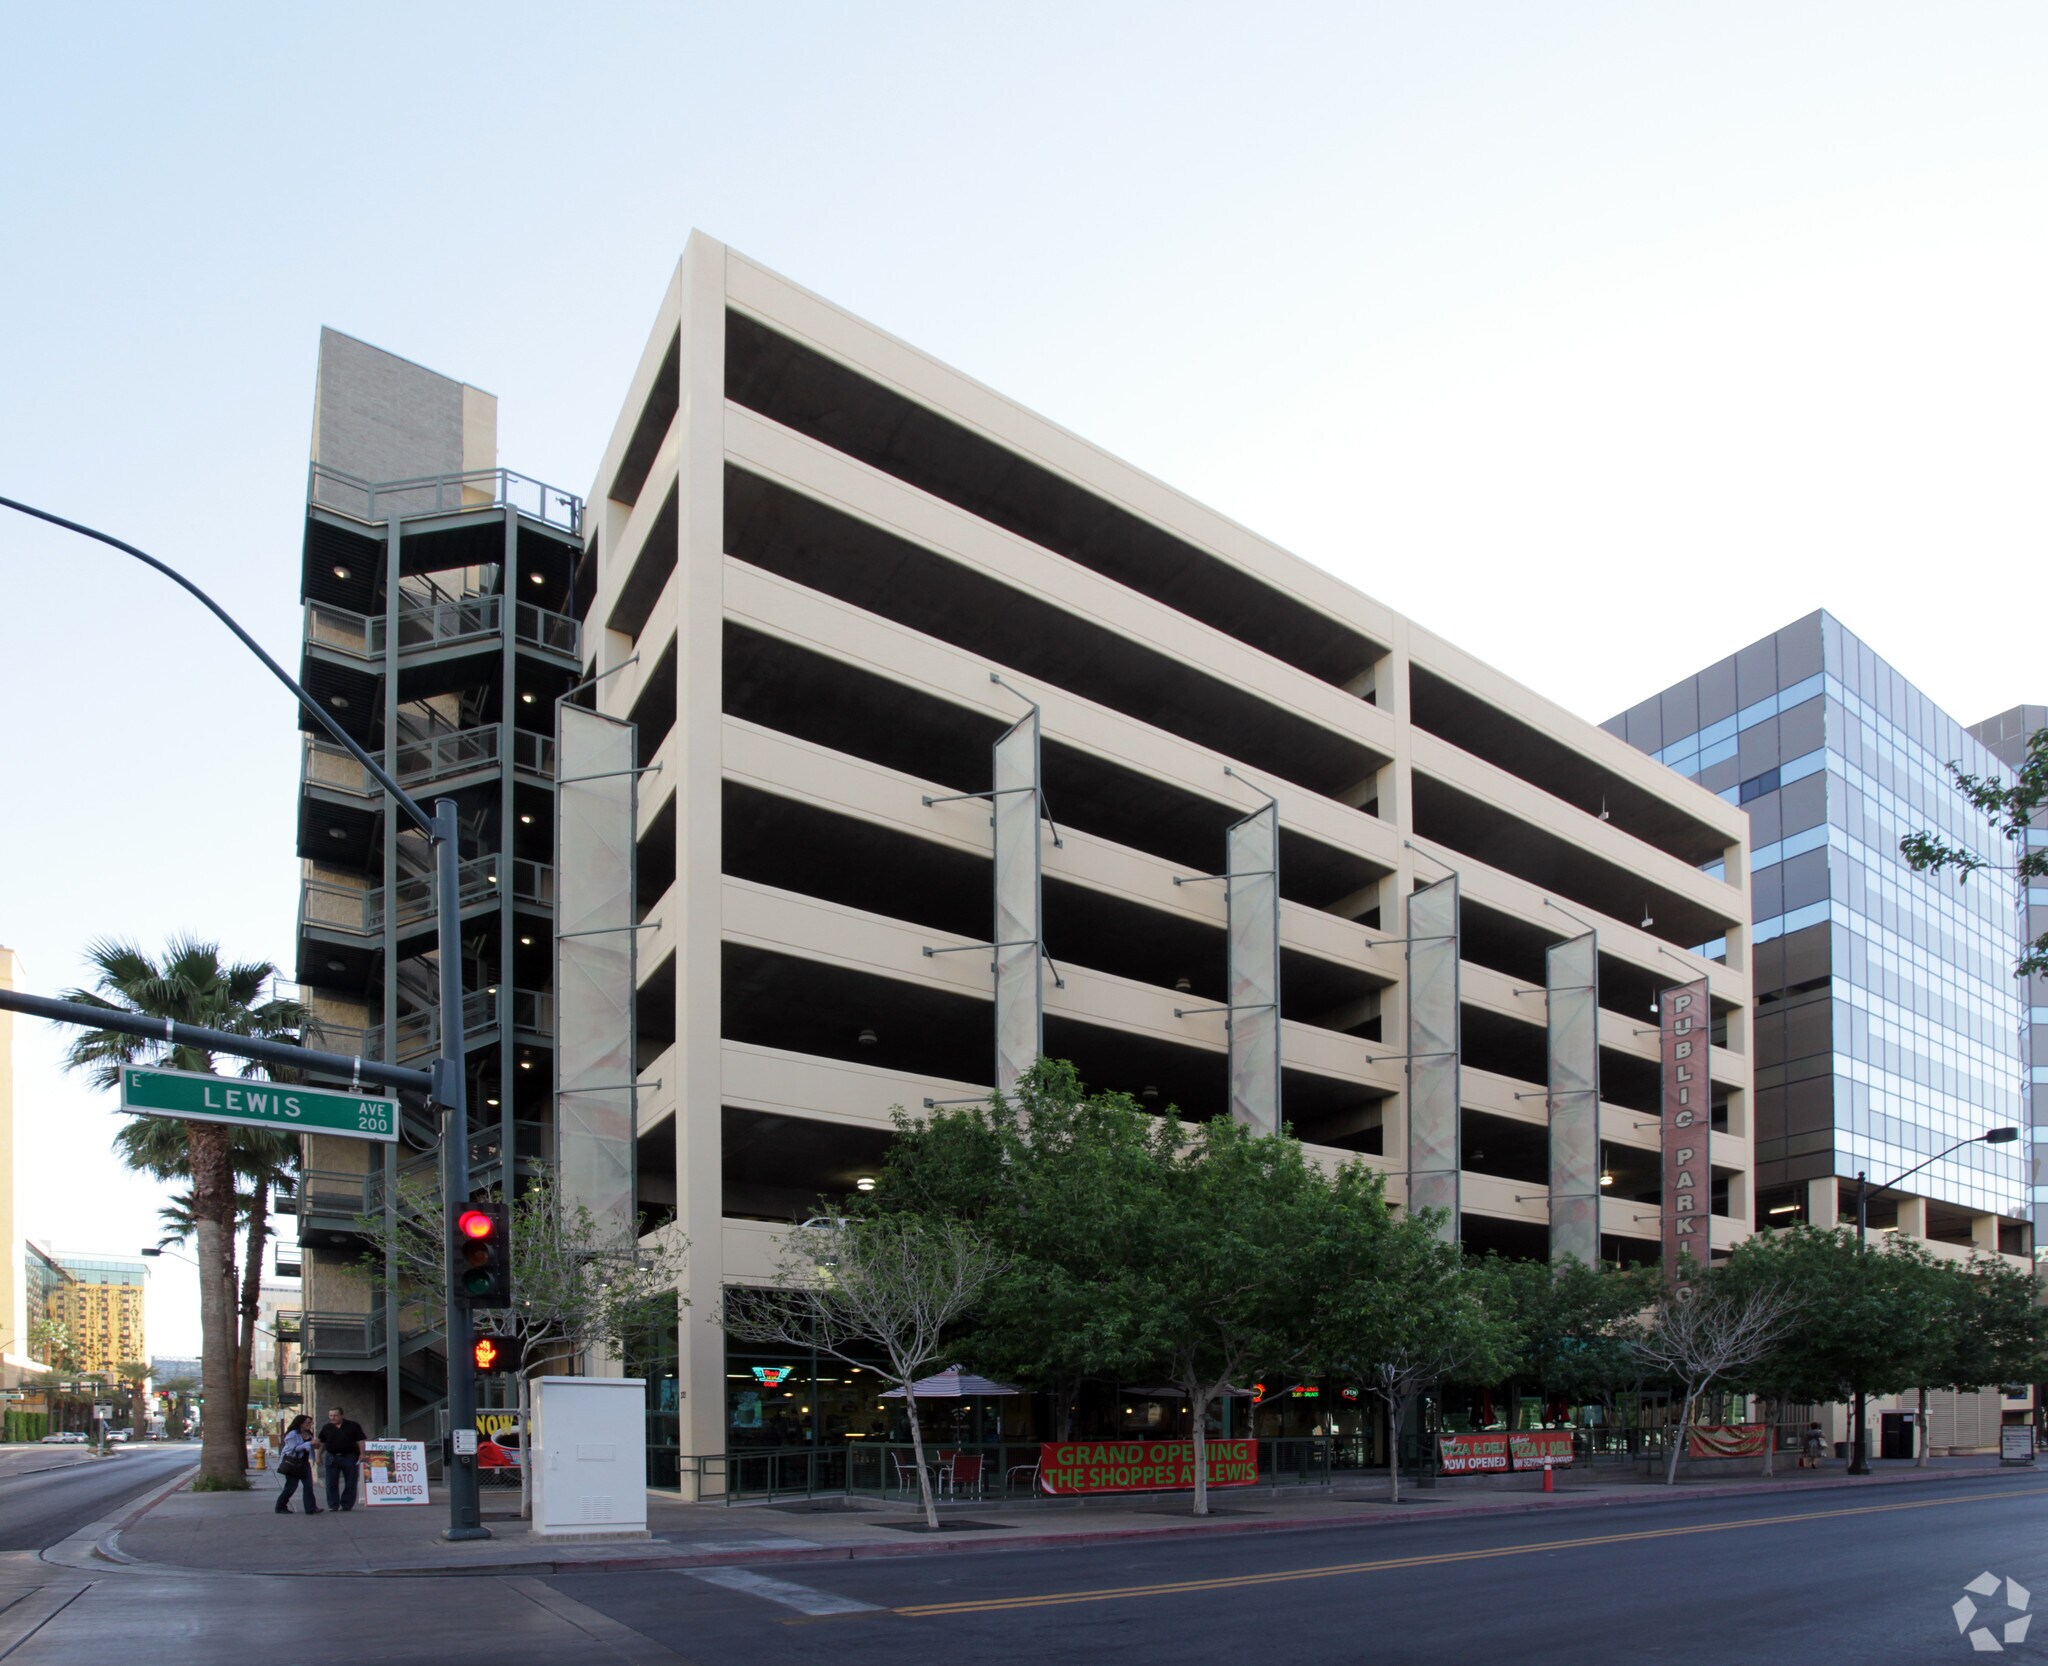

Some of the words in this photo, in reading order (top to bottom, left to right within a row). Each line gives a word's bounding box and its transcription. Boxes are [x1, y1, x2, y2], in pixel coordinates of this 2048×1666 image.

[1674, 994, 1695, 1130] PUBLIC
[131, 1073, 142, 1088] E
[204, 1086, 301, 1118] LEWIS
[358, 1101, 386, 1117] AVE
[358, 1116, 388, 1133] 200
[1674, 1147, 1697, 1303] PARKIG
[476, 1414, 514, 1436] NOW
[371, 1443, 395, 1451] Moxie
[398, 1443, 418, 1451] Java
[1056, 1445, 1144, 1466] GRAND
[1150, 1442, 1248, 1464] OPEING
[1473, 1441, 1482, 1455] &
[1483, 1441, 1506, 1455] DELI
[1510, 1441, 1538, 1458] PIZZA
[1549, 1441, 1573, 1456] DELI
[395, 1451, 412, 1461] FEE
[1468, 1456, 1506, 1470] OPENED
[395, 1462, 419, 1472] ESSO
[1045, 1467, 1085, 1488] THE
[1089, 1465, 1176, 1487] SHOPPES
[1206, 1462, 1256, 1482] LEWIS
[397, 1473, 414, 1484] ATO
[372, 1485, 423, 1496] SMOOTHIES
